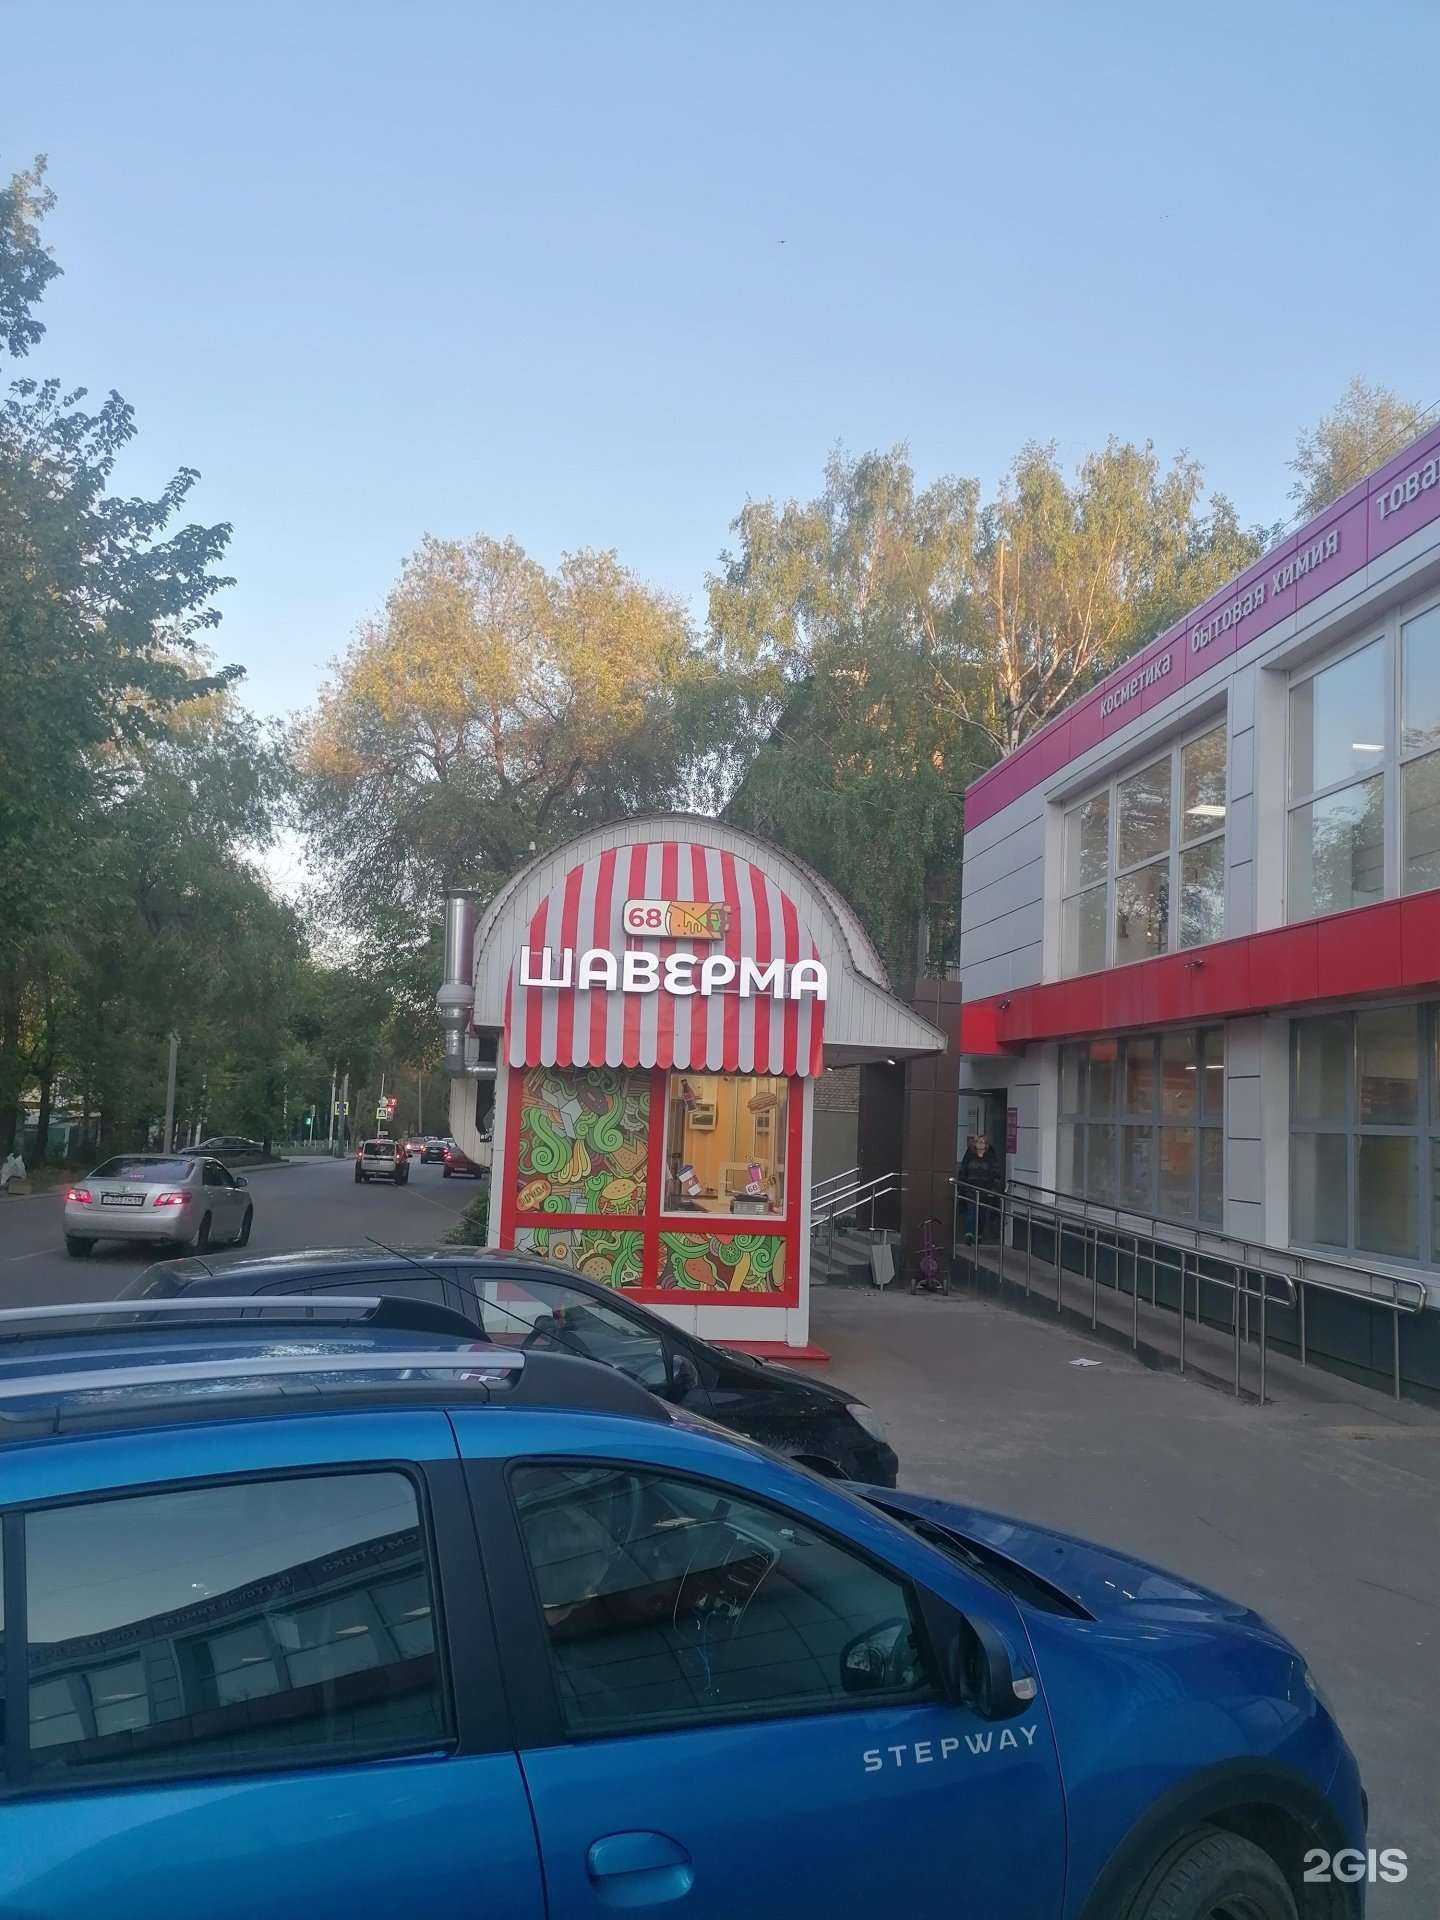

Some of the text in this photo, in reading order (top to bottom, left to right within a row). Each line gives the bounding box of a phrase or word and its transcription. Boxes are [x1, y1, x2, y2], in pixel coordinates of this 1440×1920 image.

[1376, 455, 1440, 520] това
[1191, 530, 1339, 652] бытовая химия
[1100, 653, 1171, 719] косметика
[628, 907, 662, 929] 68
[519, 944, 828, 1001] ШАВЕРМА
[863, 1724, 1038, 1772] STEPWAY
